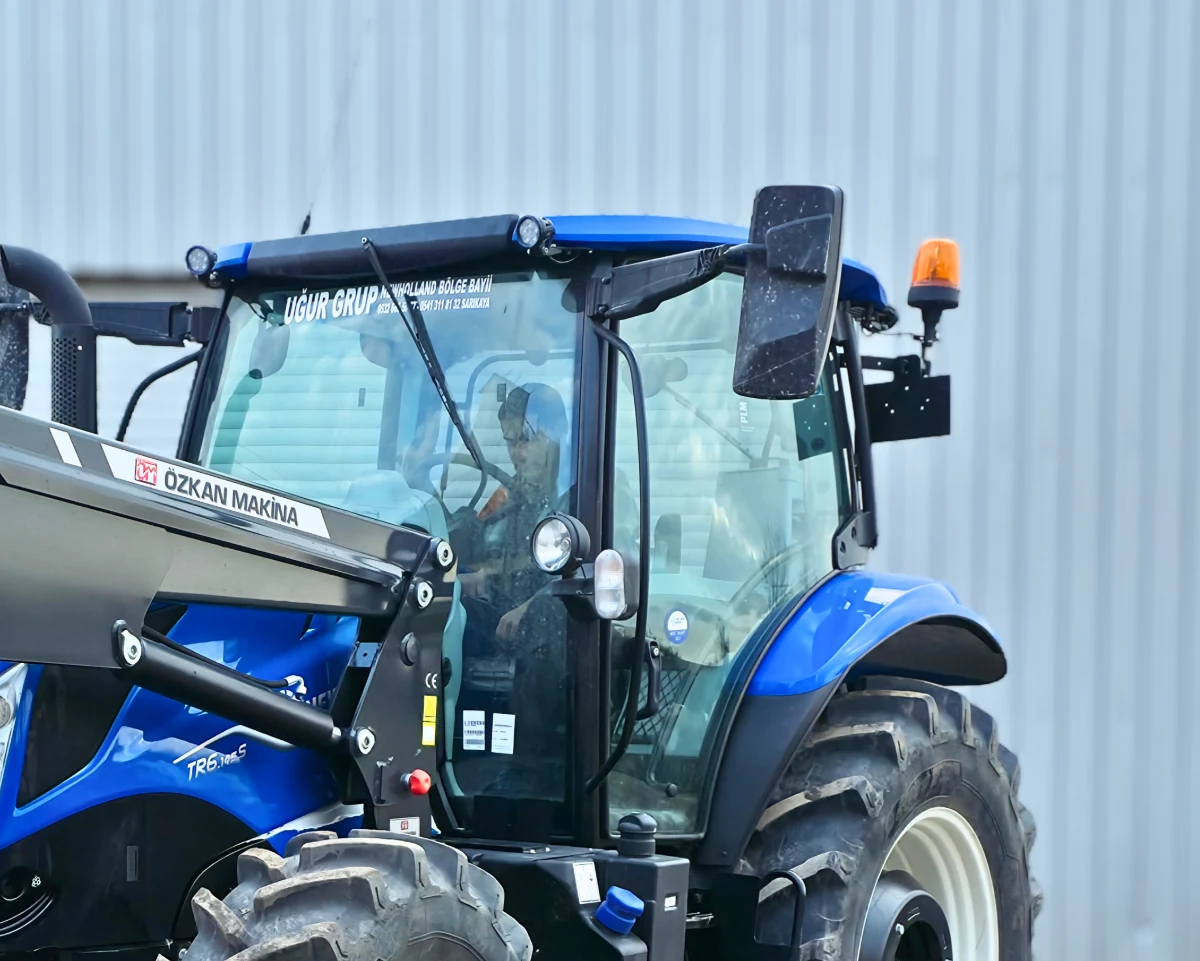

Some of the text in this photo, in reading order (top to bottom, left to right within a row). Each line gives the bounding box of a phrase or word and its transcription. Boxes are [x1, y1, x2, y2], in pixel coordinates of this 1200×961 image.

[438, 276, 468, 295] BÖLGE
[284, 285, 379, 325] UĞUR GRUP
[739, 401, 748, 424] PLM
[164, 467, 299, 527] ÖZKAN MAKİNA
